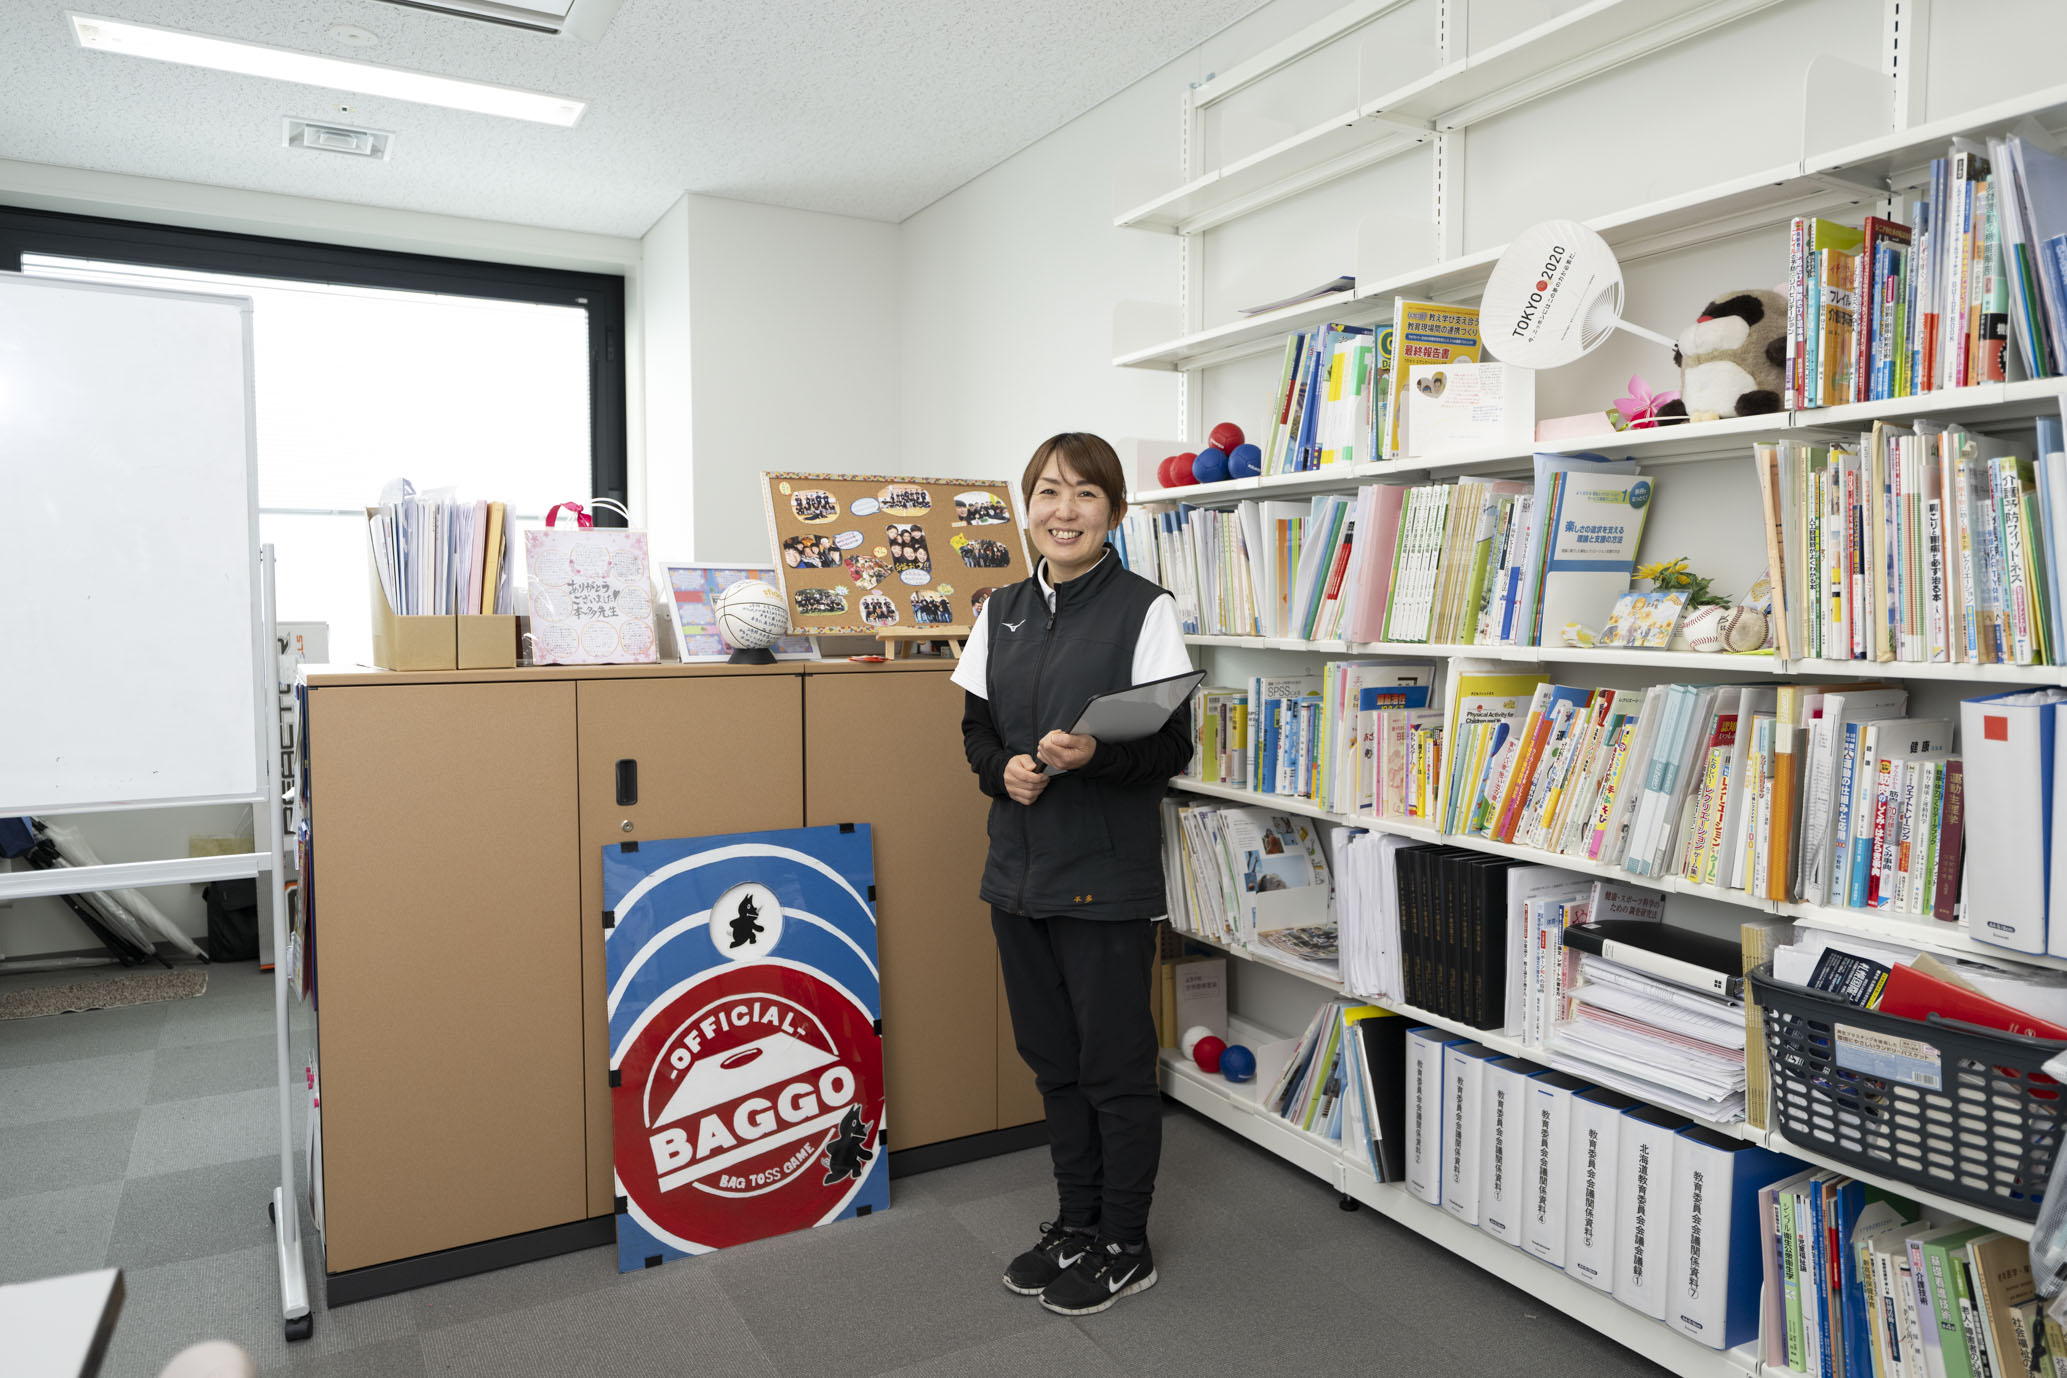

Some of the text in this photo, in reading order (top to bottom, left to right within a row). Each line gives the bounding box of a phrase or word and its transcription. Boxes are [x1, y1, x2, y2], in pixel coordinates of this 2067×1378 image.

[1512, 245, 1566, 337] TOKYO 2020
[1404, 345, 1451, 360] 最終報告書
[2002, 473, 2023, 583] 介護予防フィットネス
[567, 579, 610, 595] ありがとう
[572, 591, 614, 605] ございました
[1466, 711, 1489, 720] Physical
[1488, 711, 1507, 719] Activity
[1694, 785, 1714, 850] レクリエーション
[1948, 772, 1963, 825] 運動生理学
[649, 1065, 856, 1176] BAGGO
[719, 1141, 815, 1190] BAG TOSS GAME
